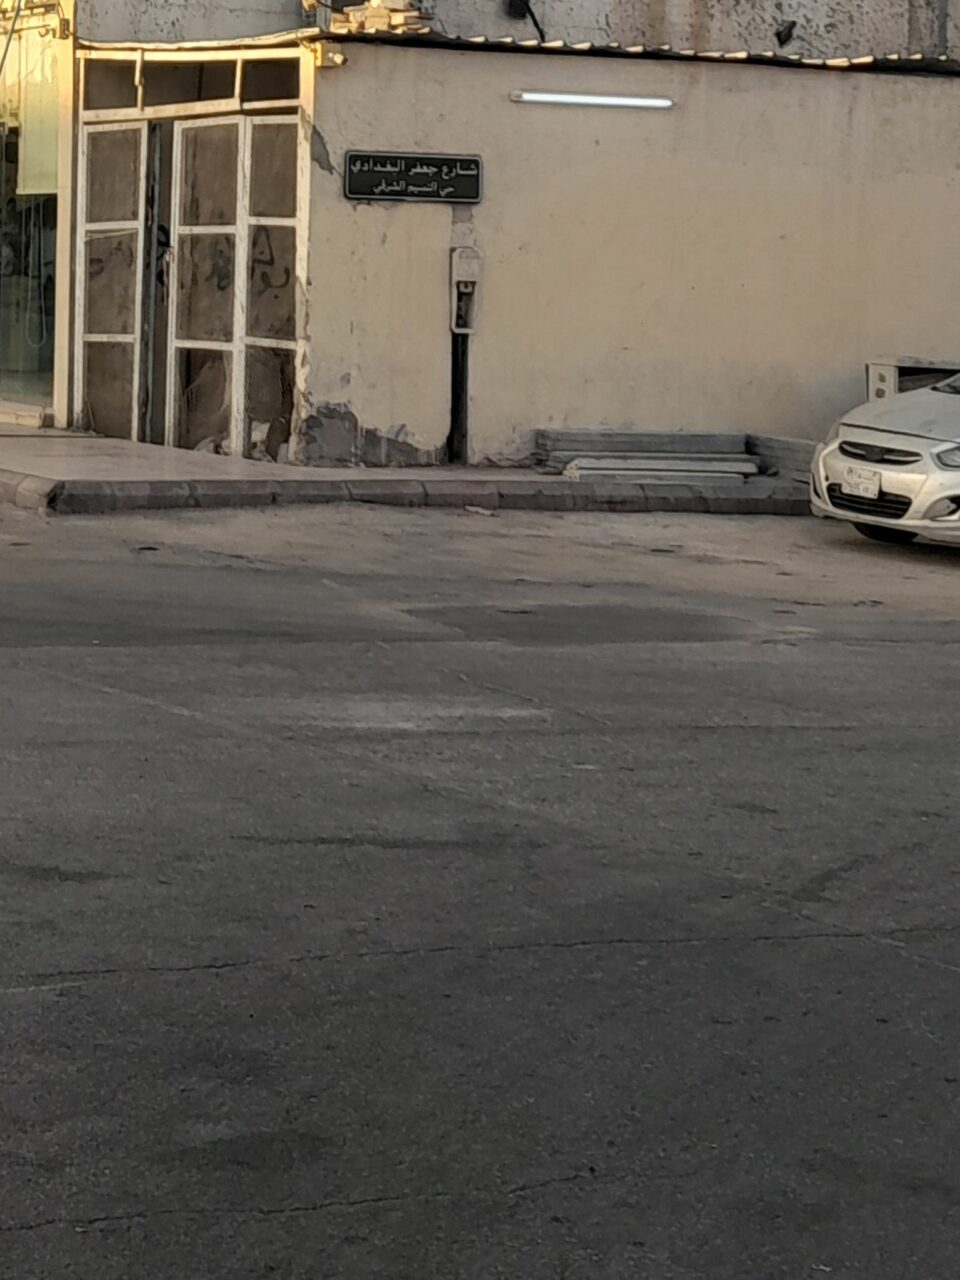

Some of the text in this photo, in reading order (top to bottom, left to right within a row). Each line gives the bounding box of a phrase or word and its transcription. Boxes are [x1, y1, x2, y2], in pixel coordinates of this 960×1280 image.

[350, 158, 478, 180] شارع جعفر البغدادي
[372, 178, 455, 197] حي النسيم الشرقي
